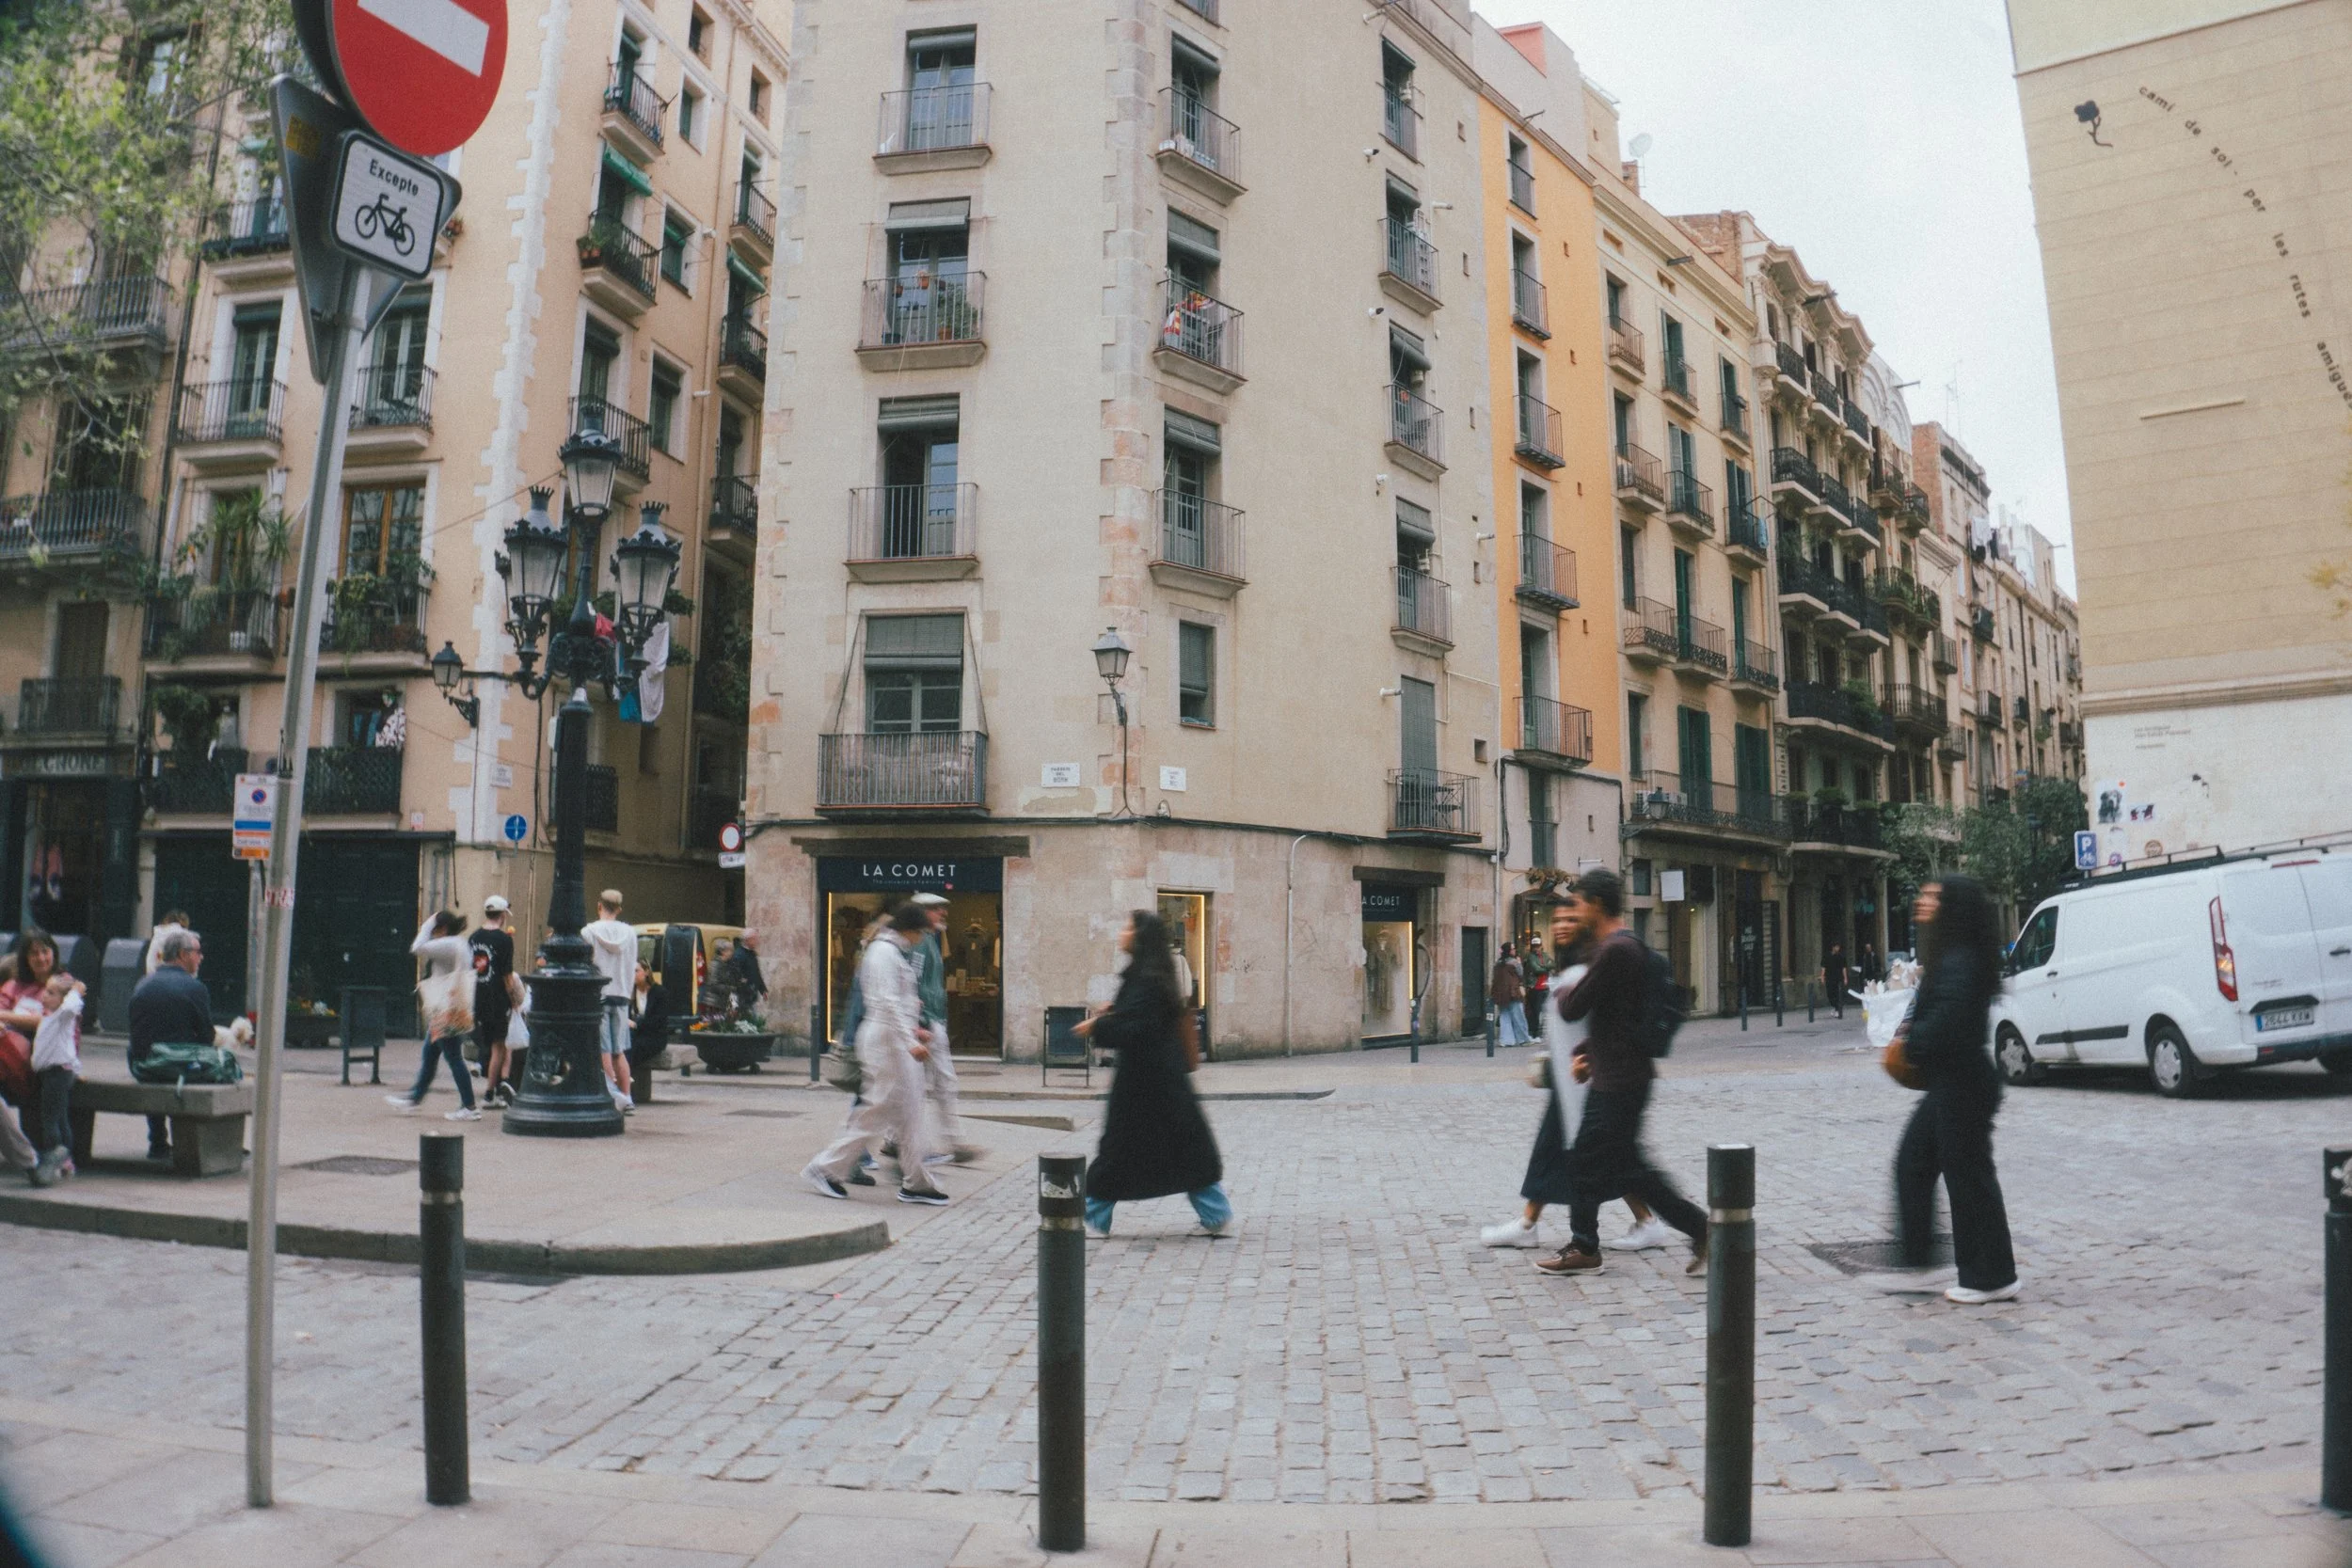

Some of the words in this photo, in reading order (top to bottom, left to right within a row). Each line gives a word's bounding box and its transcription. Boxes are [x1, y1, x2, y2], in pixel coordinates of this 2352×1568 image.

[369, 158, 420, 197] Excepte
[2185, 119, 2201, 135] de
[2243, 188, 2265, 212] per
[2272, 232, 2289, 257] les
[2289, 274, 2311, 318] rutes
[2081, 836, 2092, 851] P
[863, 864, 883, 876] LA
[891, 864, 956, 877] COMET
[1370, 895, 1400, 906] COMET
